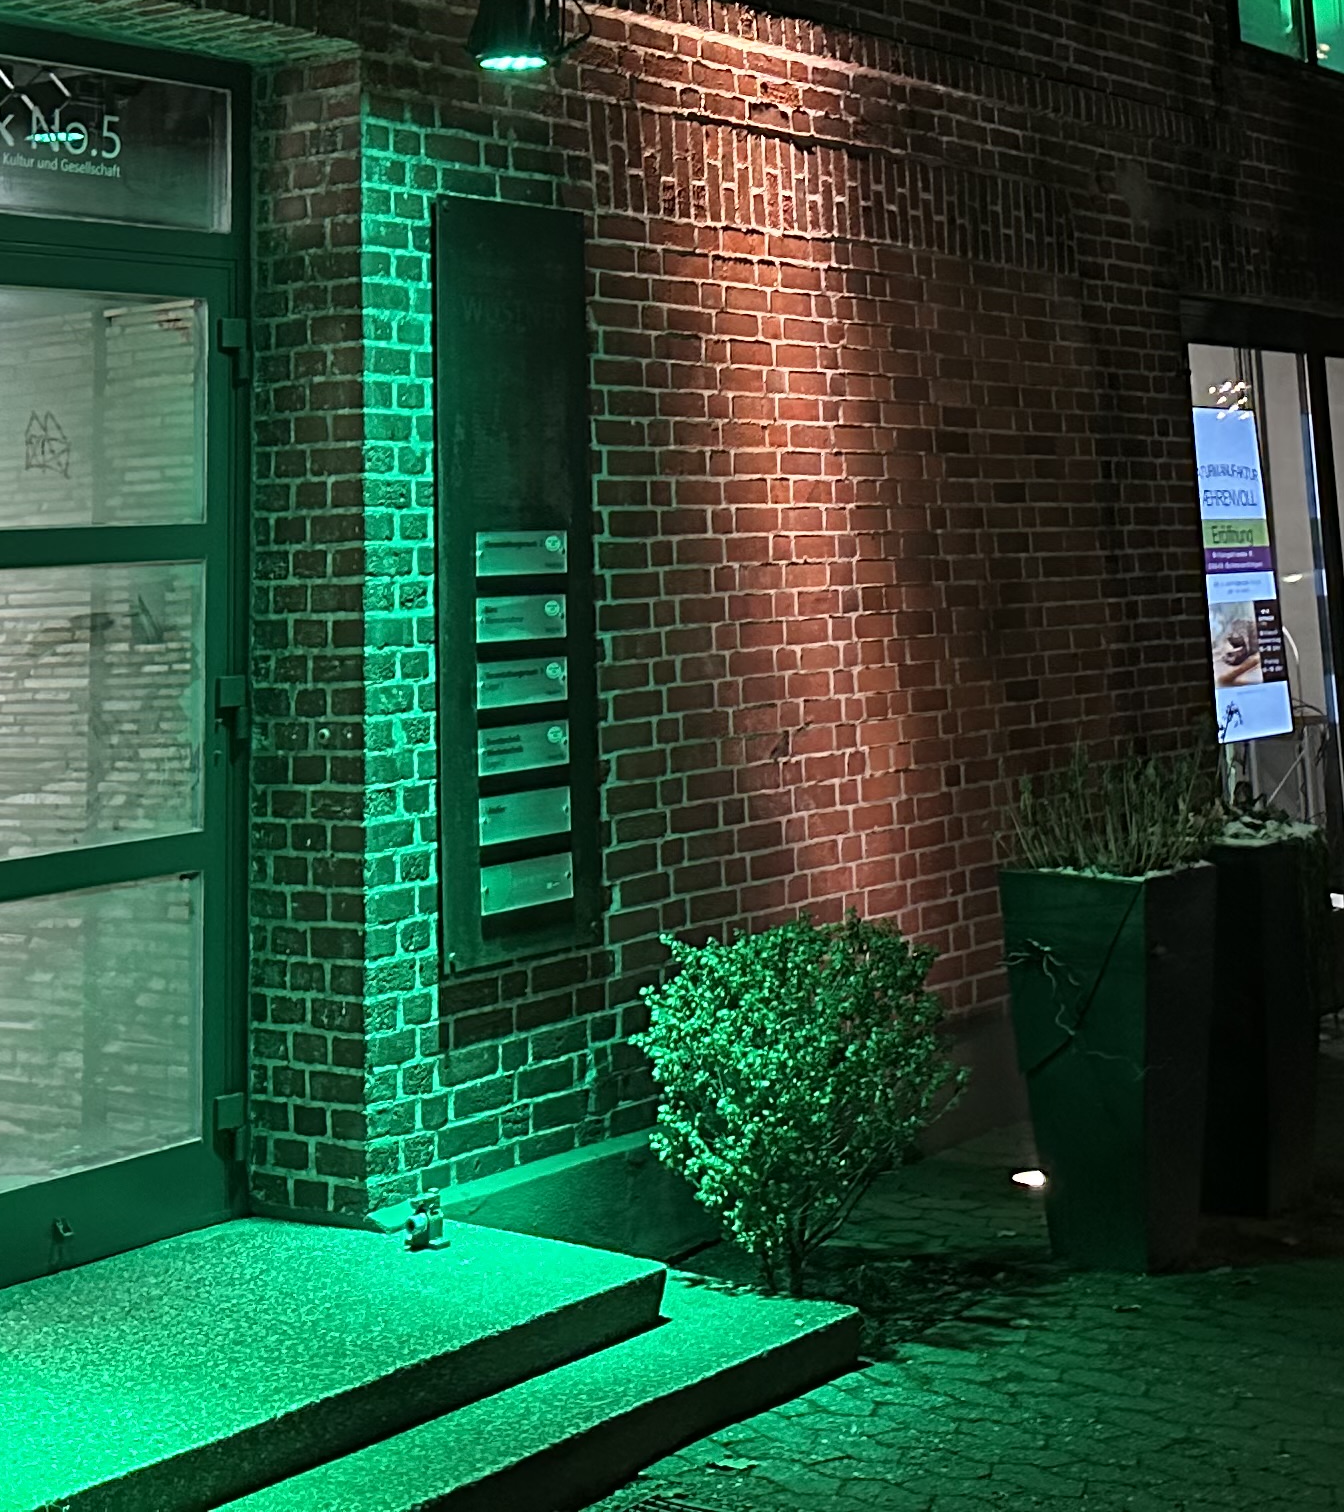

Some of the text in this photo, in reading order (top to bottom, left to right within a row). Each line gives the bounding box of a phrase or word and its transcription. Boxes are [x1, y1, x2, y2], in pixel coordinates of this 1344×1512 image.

[31, 105, 121, 159] No.5
[2, 151, 35, 168] Kultur
[37, 157, 58, 172] und
[60, 158, 121, 178] Gesellschaft
[1211, 524, 1254, 546] Eröffnung
